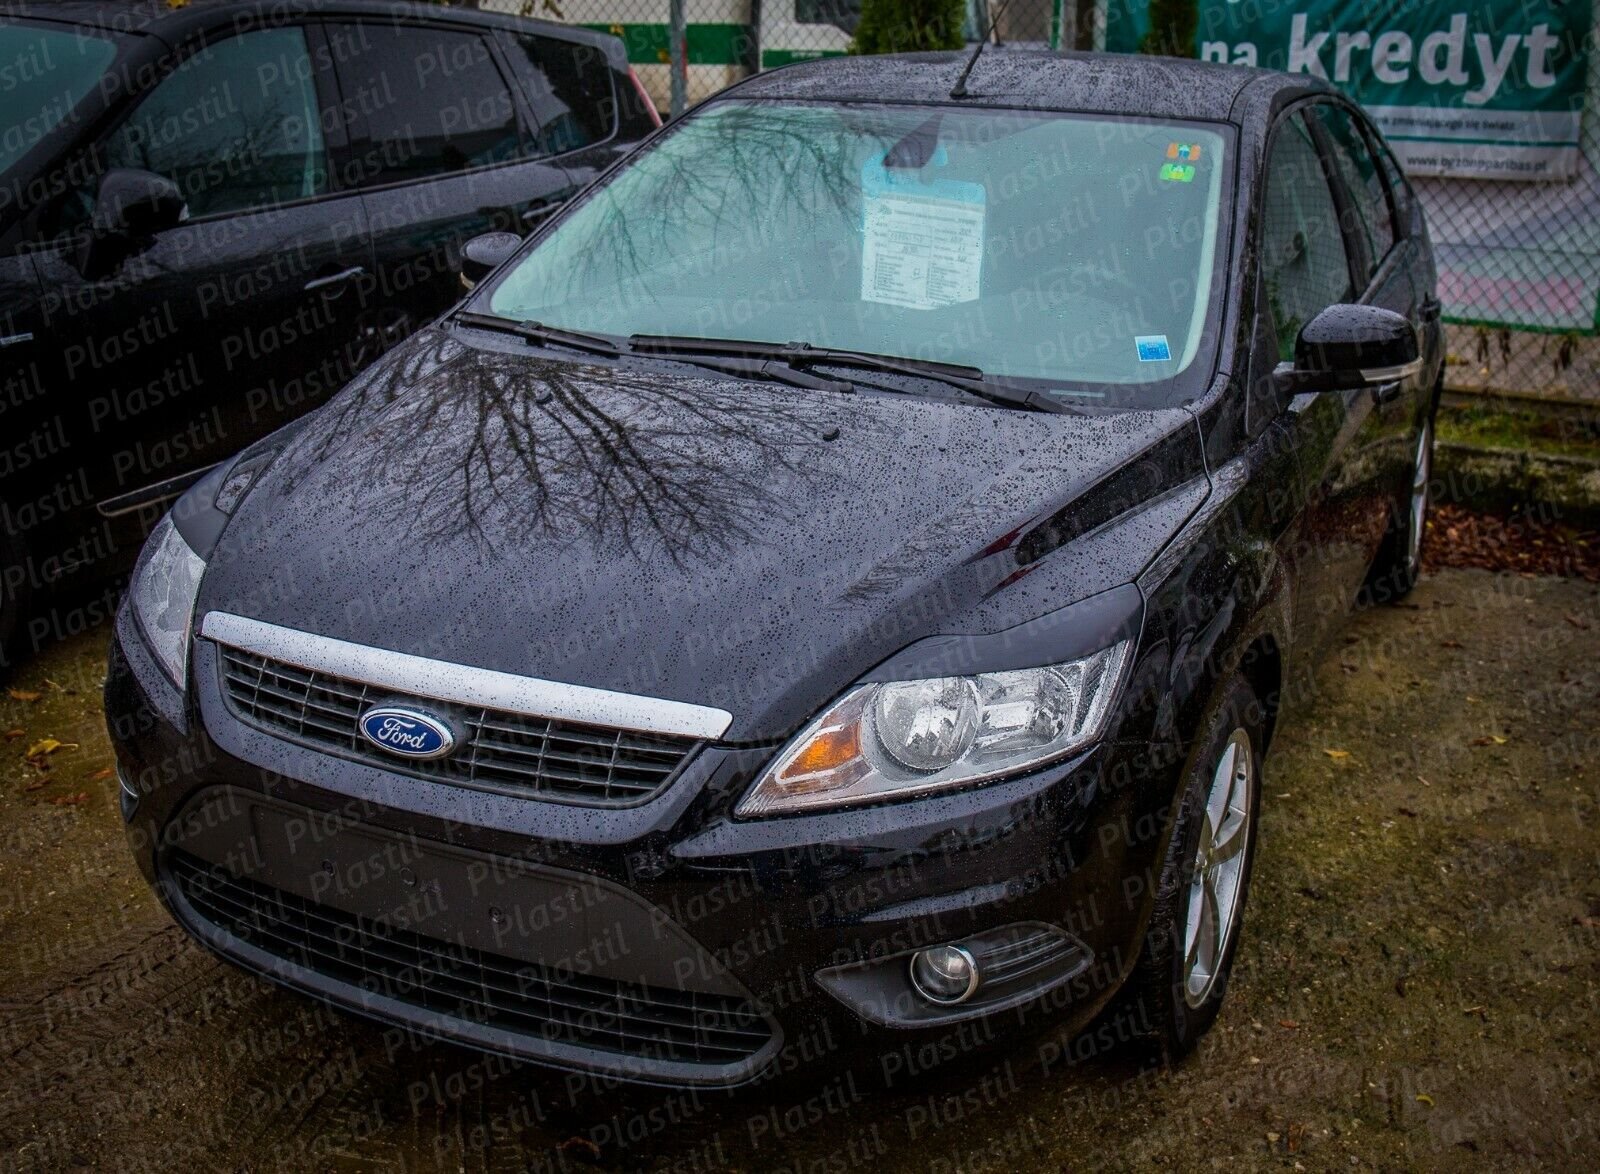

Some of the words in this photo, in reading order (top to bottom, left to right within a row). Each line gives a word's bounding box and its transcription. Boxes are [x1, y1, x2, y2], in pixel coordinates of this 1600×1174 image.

[1201, 41, 1257, 67] na
[1287, 12, 1560, 106] kredyt
[377, 717, 428, 749] Ford
